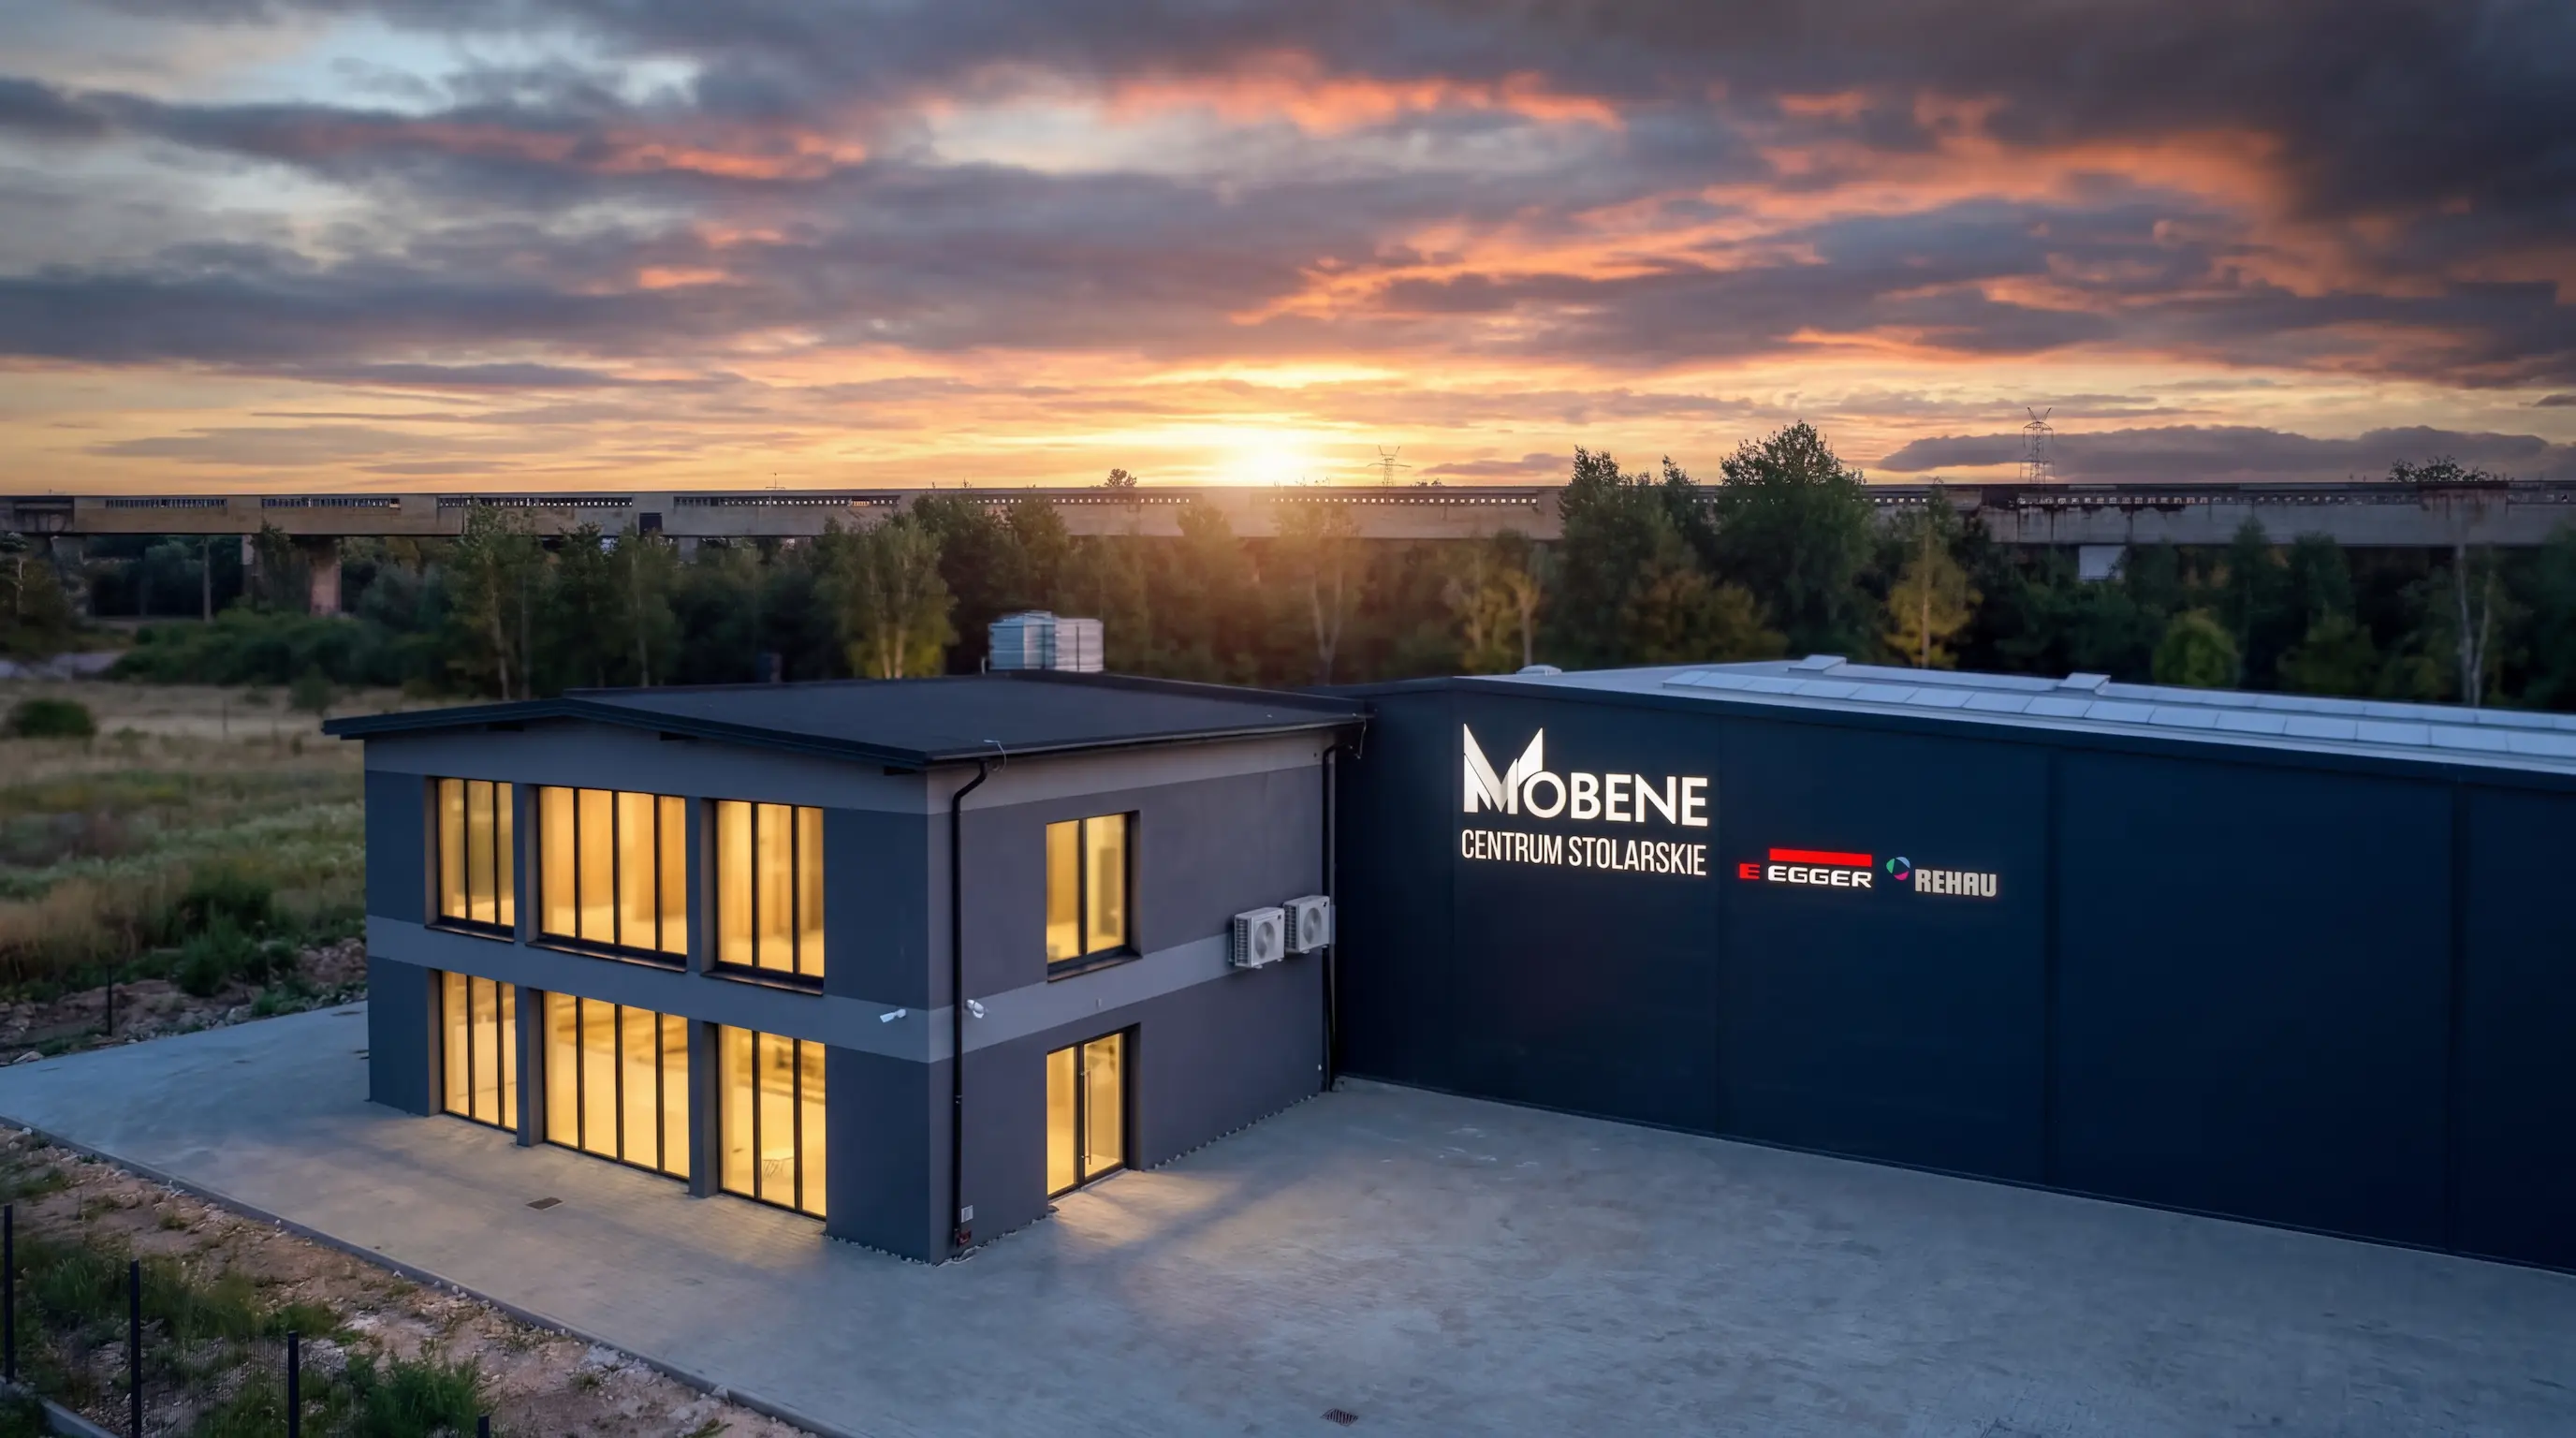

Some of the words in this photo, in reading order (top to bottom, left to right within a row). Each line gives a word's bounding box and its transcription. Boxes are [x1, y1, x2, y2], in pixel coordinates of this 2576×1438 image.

[1463, 723, 1709, 828] MOBENE
[1461, 829, 1562, 865] CENTRUM
[1568, 835, 1707, 876] STOLARSKIE
[1767, 864, 1873, 888] EGGER
[1914, 868, 1998, 898] REHAU
